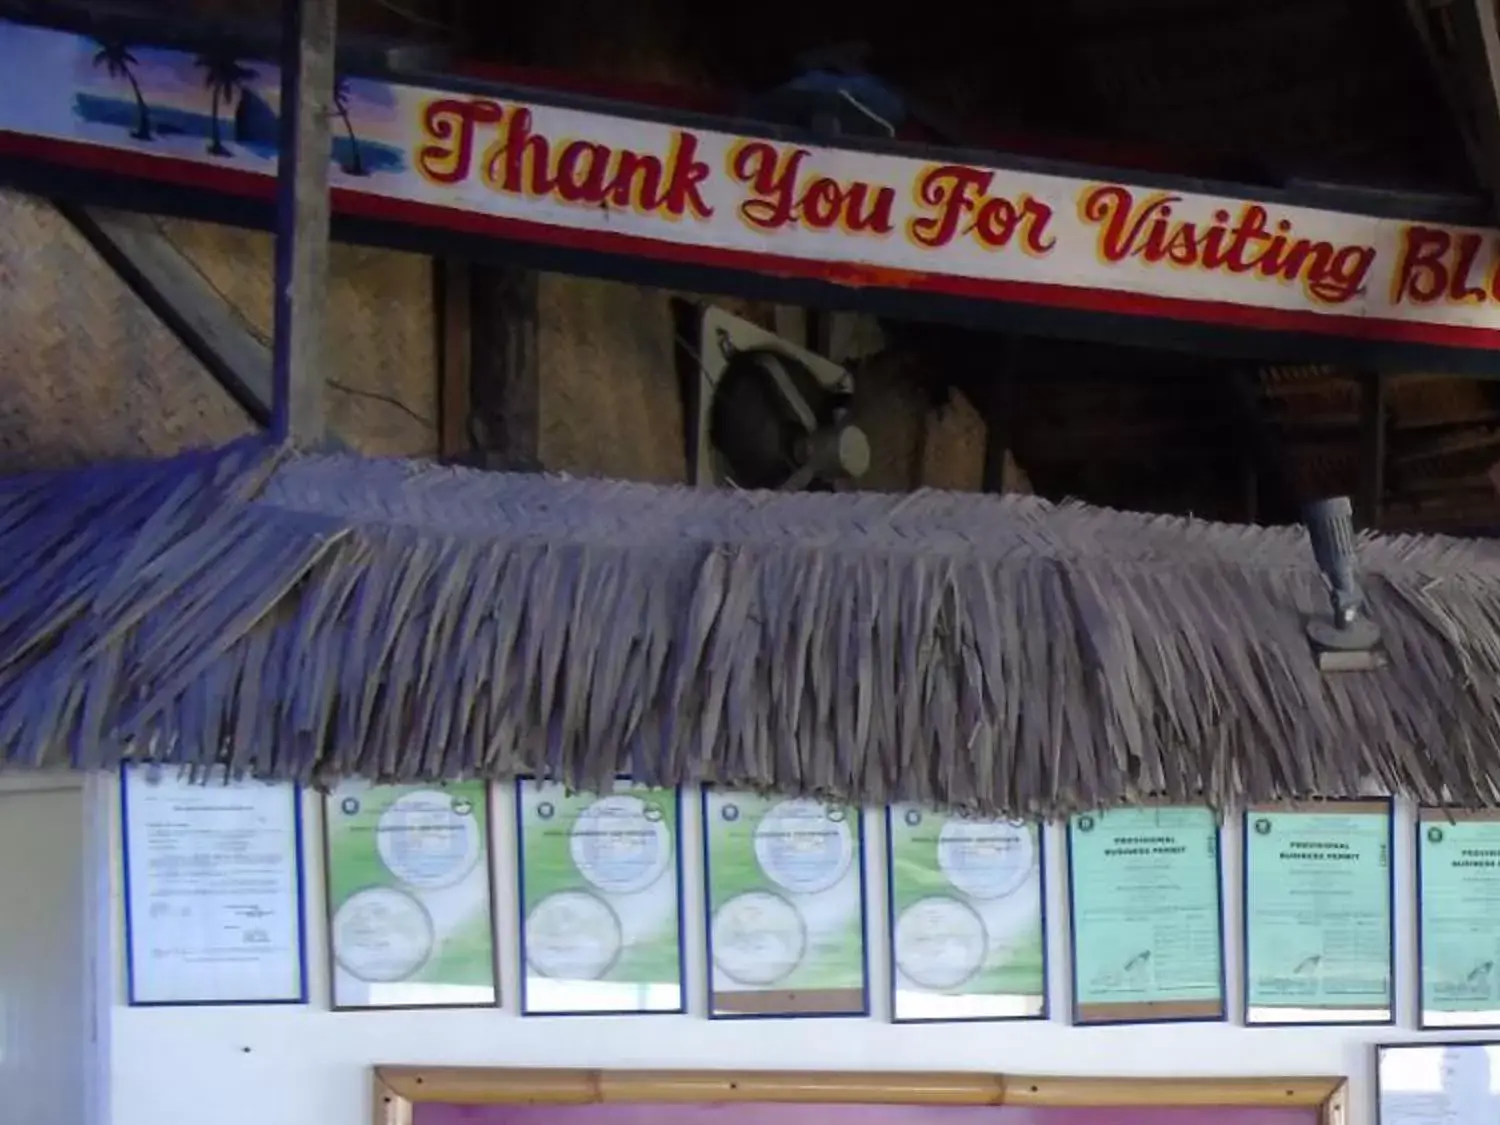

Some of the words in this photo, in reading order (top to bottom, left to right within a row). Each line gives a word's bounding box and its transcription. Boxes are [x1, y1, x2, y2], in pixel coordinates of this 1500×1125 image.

[416, 97, 714, 218] Thank
[724, 136, 895, 238] You
[911, 164, 1057, 254] For
[1078, 183, 1376, 303] Visiting
